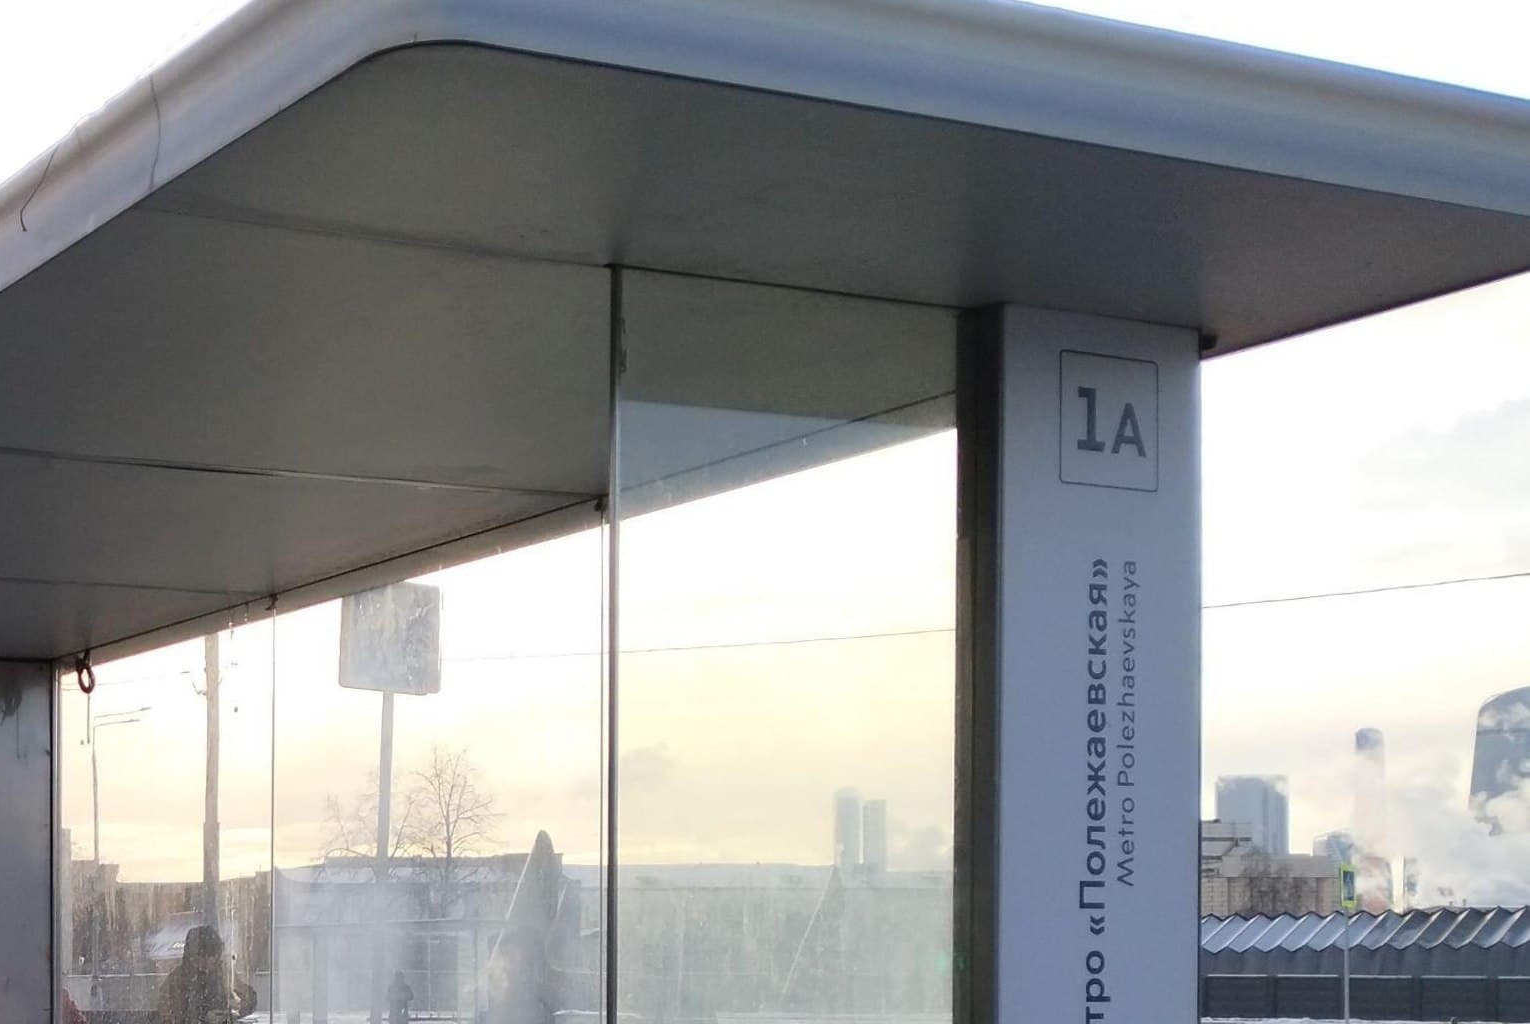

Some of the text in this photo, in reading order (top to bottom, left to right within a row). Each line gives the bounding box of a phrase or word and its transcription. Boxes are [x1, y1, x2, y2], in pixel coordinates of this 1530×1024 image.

[1079, 558, 1109, 936] «Полежаевская»
[1117, 560, 1141, 887] Metro Polezhaevskaya
